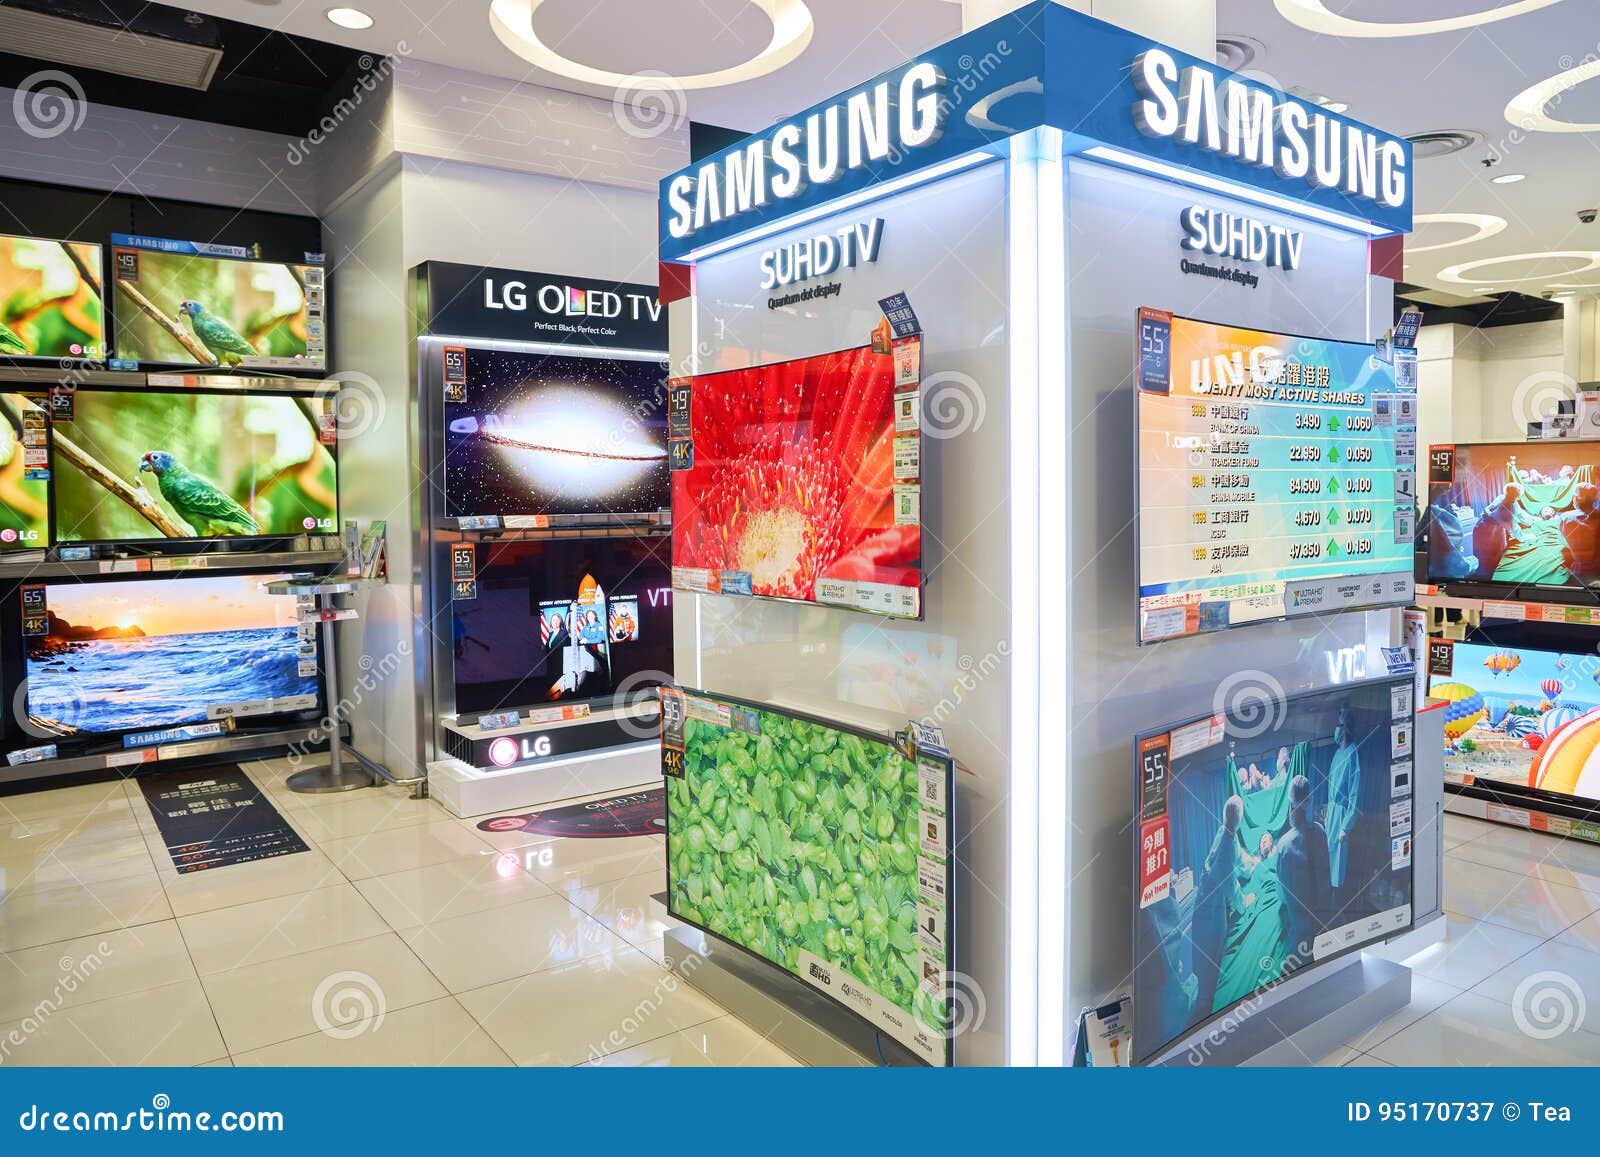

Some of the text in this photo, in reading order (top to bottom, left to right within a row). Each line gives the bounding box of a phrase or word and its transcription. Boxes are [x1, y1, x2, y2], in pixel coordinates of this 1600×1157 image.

[1138, 49, 1405, 208] SAMSUNG
[668, 63, 941, 239] SAMSUNG
[127, 237, 178, 250] SAMSUNG
[1181, 258, 1218, 278] Quantum
[1232, 269, 1259, 288] display
[484, 278, 662, 321] LG OLED TV
[768, 290, 799, 310] Quantum
[813, 282, 842, 300] display
[534, 321, 557, 332] Perfect
[577, 325, 600, 335] Perfect
[600, 327, 617, 336] Color
[83, 345, 97, 354] LG
[448, 385, 463, 395] 4K
[1201, 382, 1366, 406] WENTY MOST ACTIVE SHARES
[1295, 413, 1372, 431] 3.490 0.060
[672, 443, 689, 459] 4K
[1290, 445, 1372, 462] 22.950 0.050
[1290, 477, 1372, 494] 84.500 0.100
[317, 518, 332, 528] LG
[1295, 508, 1372, 526] 4.670 0.070
[19, 530, 38, 541] LG
[1289, 538, 1372, 560] 47.350 0.150
[456, 582, 472, 593] 4K
[26, 619, 44, 629] 4K
[1389, 653, 1407, 664] NEW
[128, 730, 182, 746] SAMSUNG
[521, 736, 551, 758] LG
[664, 751, 682, 768] 4K
[1143, 827, 1165, 853] 今期
[1146, 847, 1168, 877] 推介
[1143, 881, 1168, 903] Hot Item
